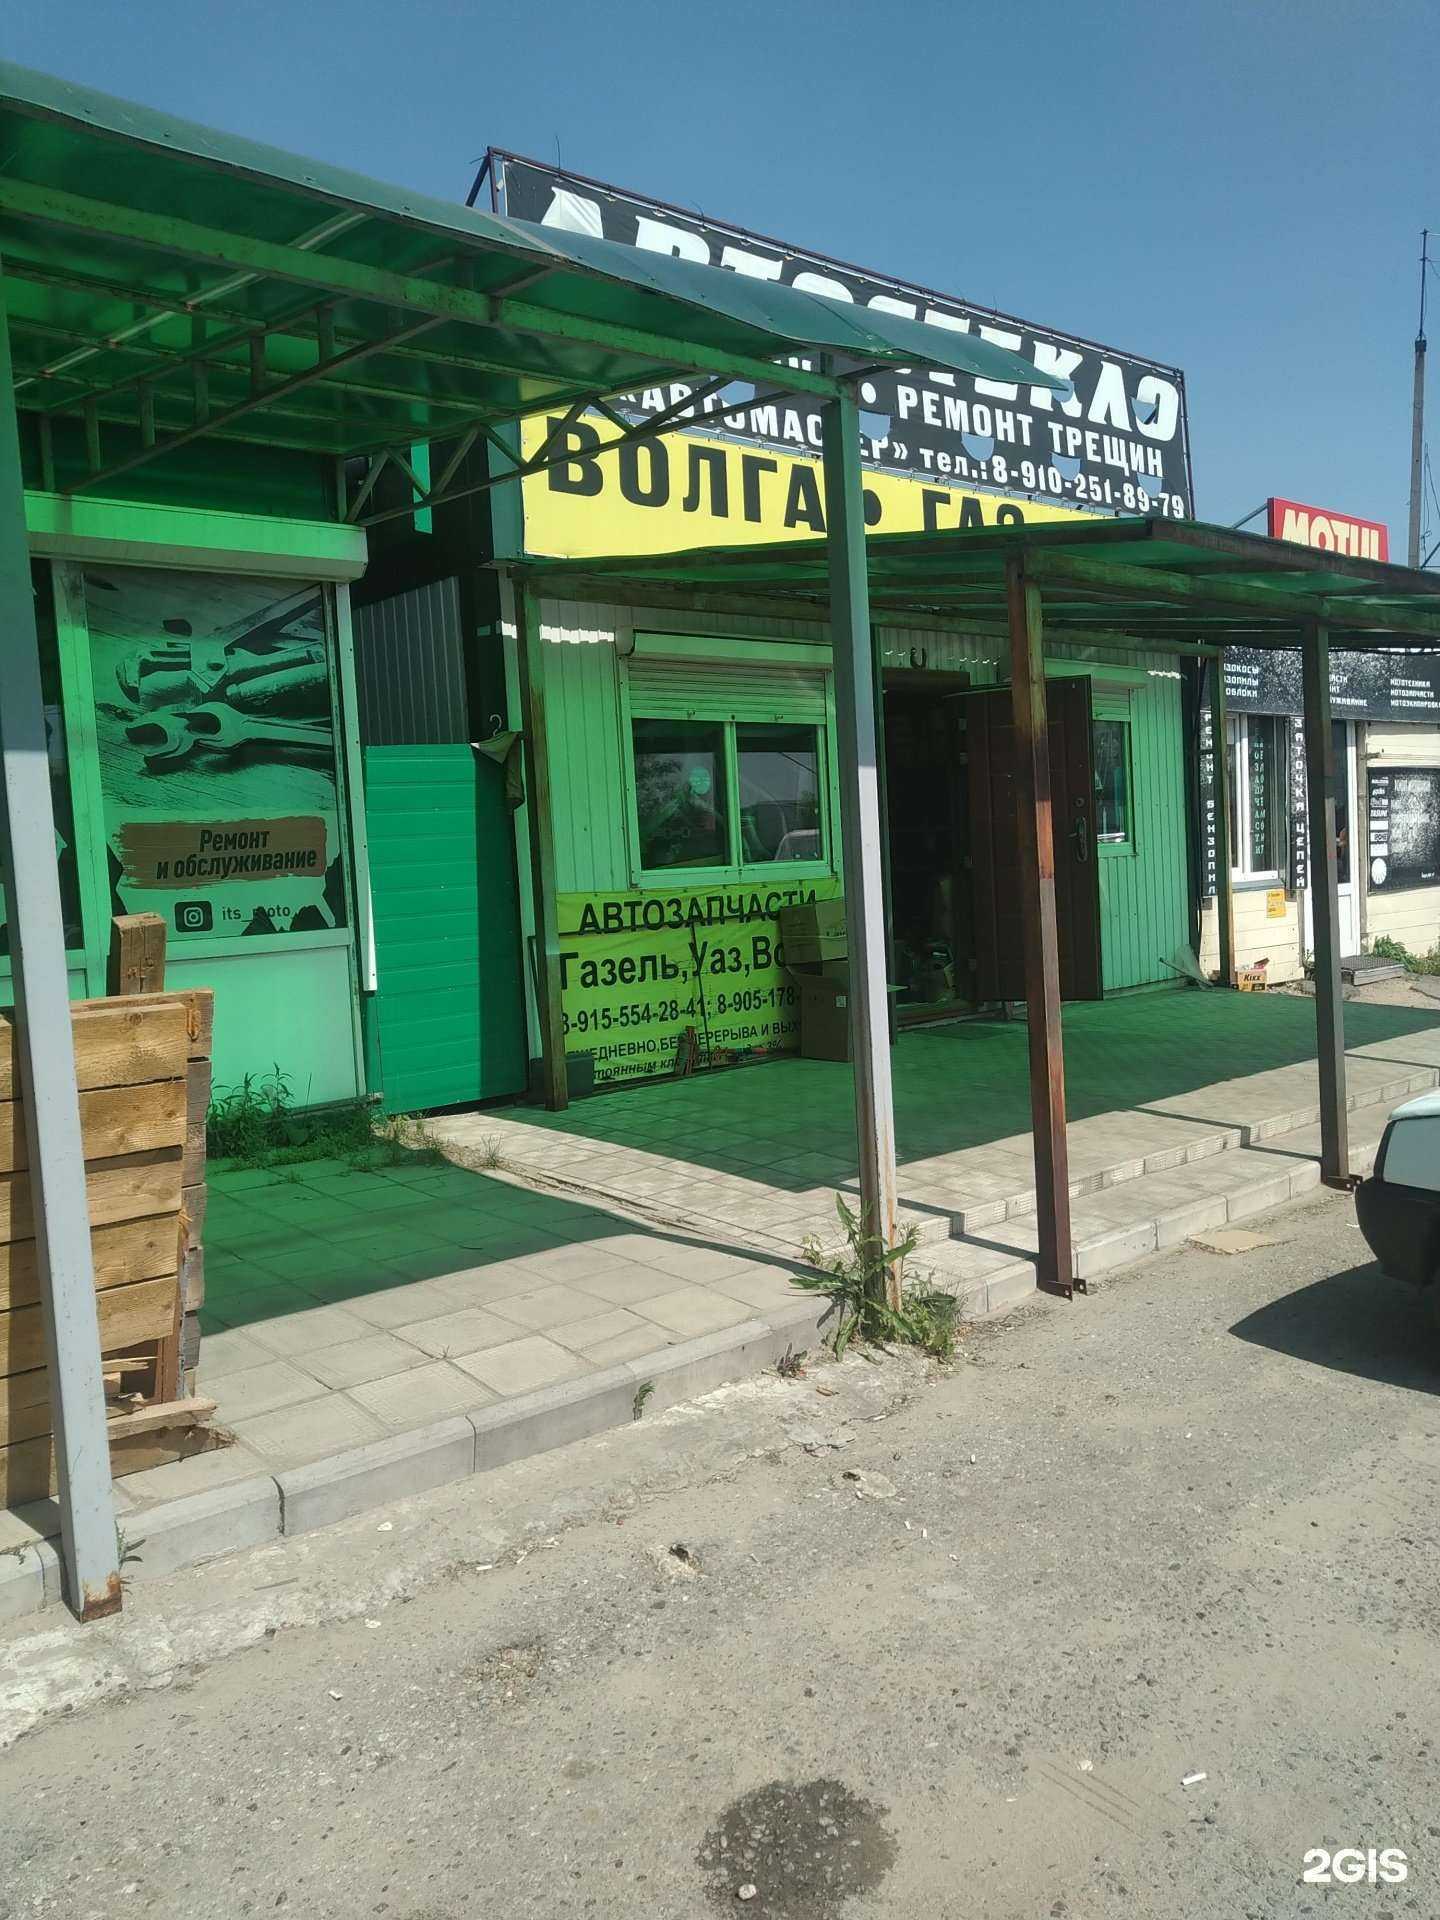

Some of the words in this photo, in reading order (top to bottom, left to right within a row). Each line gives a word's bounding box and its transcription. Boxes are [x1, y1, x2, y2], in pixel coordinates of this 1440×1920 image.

[897, 384, 1033, 447] РЕМОНТ
[1047, 421, 1164, 478] ТРЕЩИН
[546, 415, 829, 533] ВОЛГА
[200, 829, 270, 853] Ремонт
[156, 861, 169, 880] и
[173, 850, 317, 879] обслуживание
[578, 888, 817, 936] АВТОЗАПЧАСТИ
[761, 1025, 769, 1037] И
